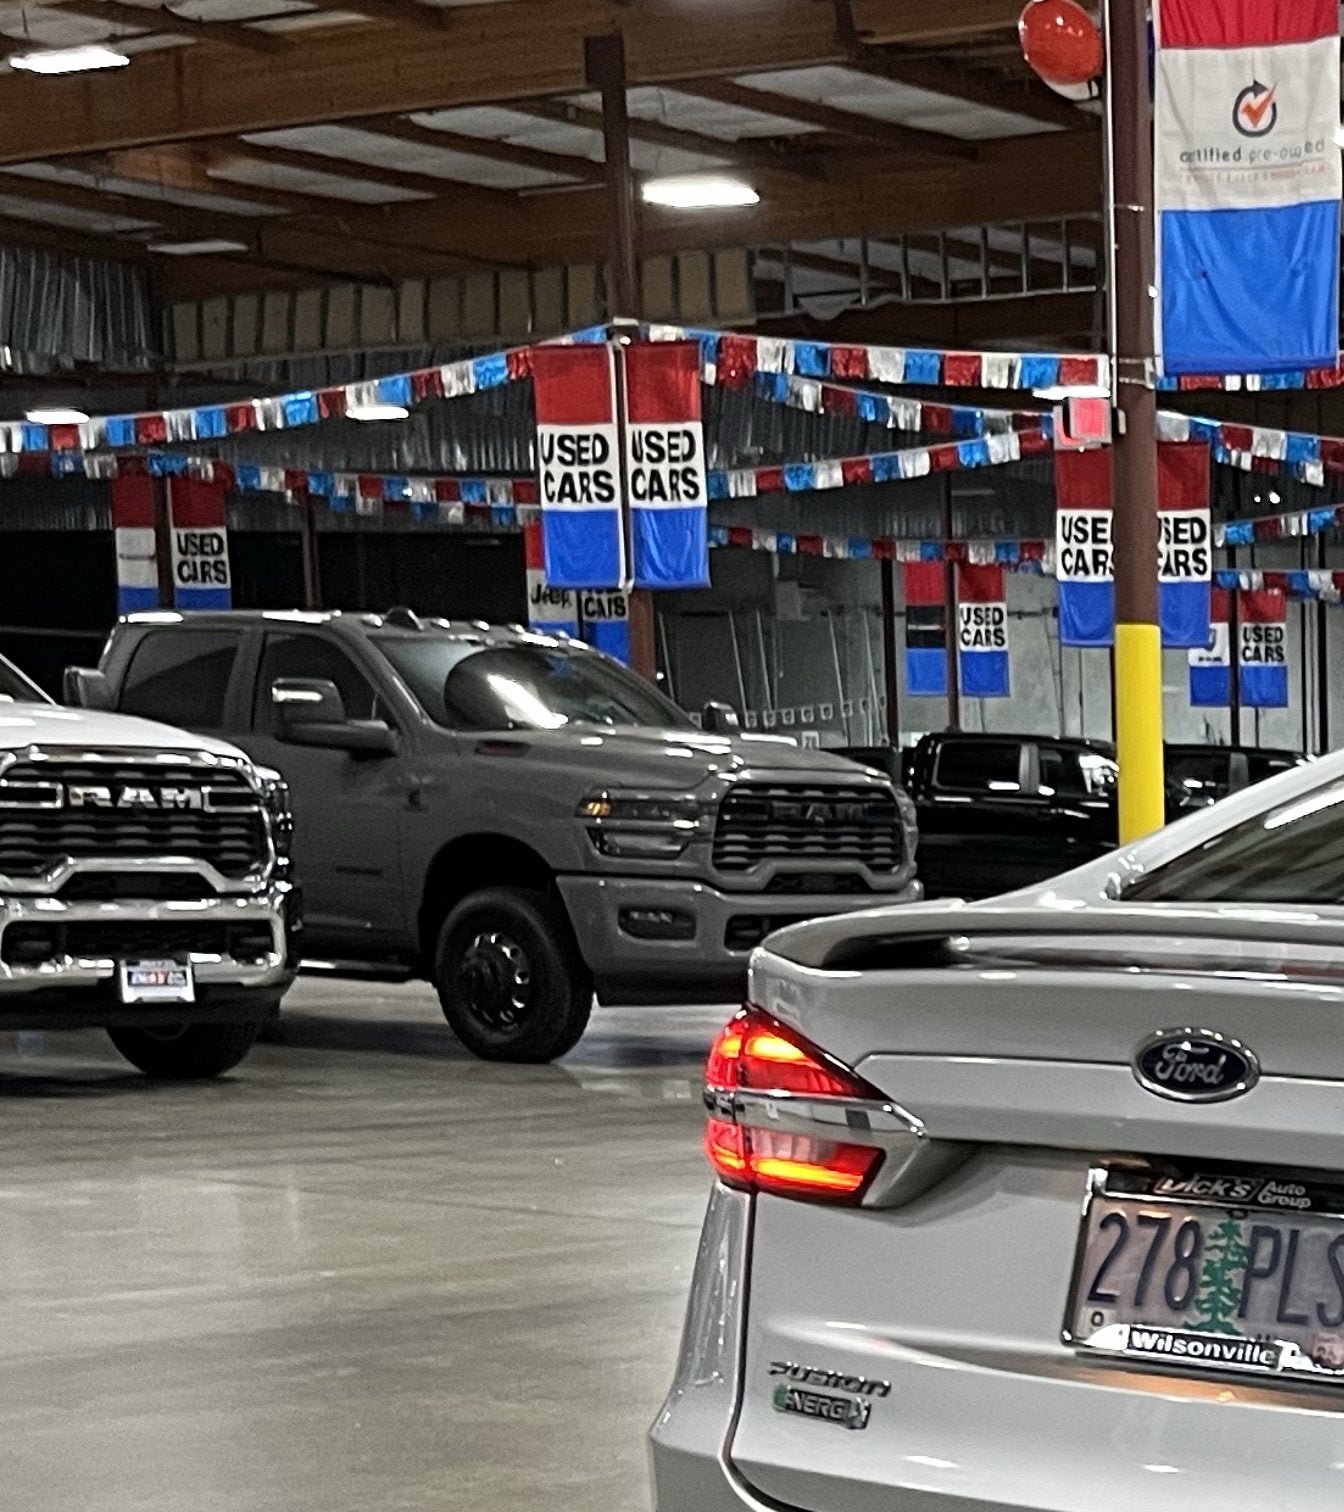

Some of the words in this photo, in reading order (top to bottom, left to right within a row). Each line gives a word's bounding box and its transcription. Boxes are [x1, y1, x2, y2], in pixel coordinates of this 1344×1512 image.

[1248, 138, 1325, 165] pre-owed
[540, 432, 610, 467] USED
[631, 430, 696, 464] USED
[543, 469, 615, 503] CARS
[631, 467, 700, 501] CARS
[1061, 516, 1114, 544] USE
[1158, 516, 1207, 545] SED
[176, 532, 224, 557] USED
[1061, 548, 1114, 577] CAR
[1157, 548, 1208, 577] ARS
[960, 607, 1004, 626] USED
[961, 628, 1005, 647] CARS
[1243, 626, 1284, 643] USED
[1242, 645, 1285, 663] CARS
[67, 785, 202, 809] RAM
[1154, 1041, 1227, 1085] Ford
[1257, 1191, 1312, 1209] Group
[1264, 1180, 1306, 1196] Auto
[1087, 1209, 1202, 1311] 278
[1131, 1328, 1278, 1365] Wilsonville
